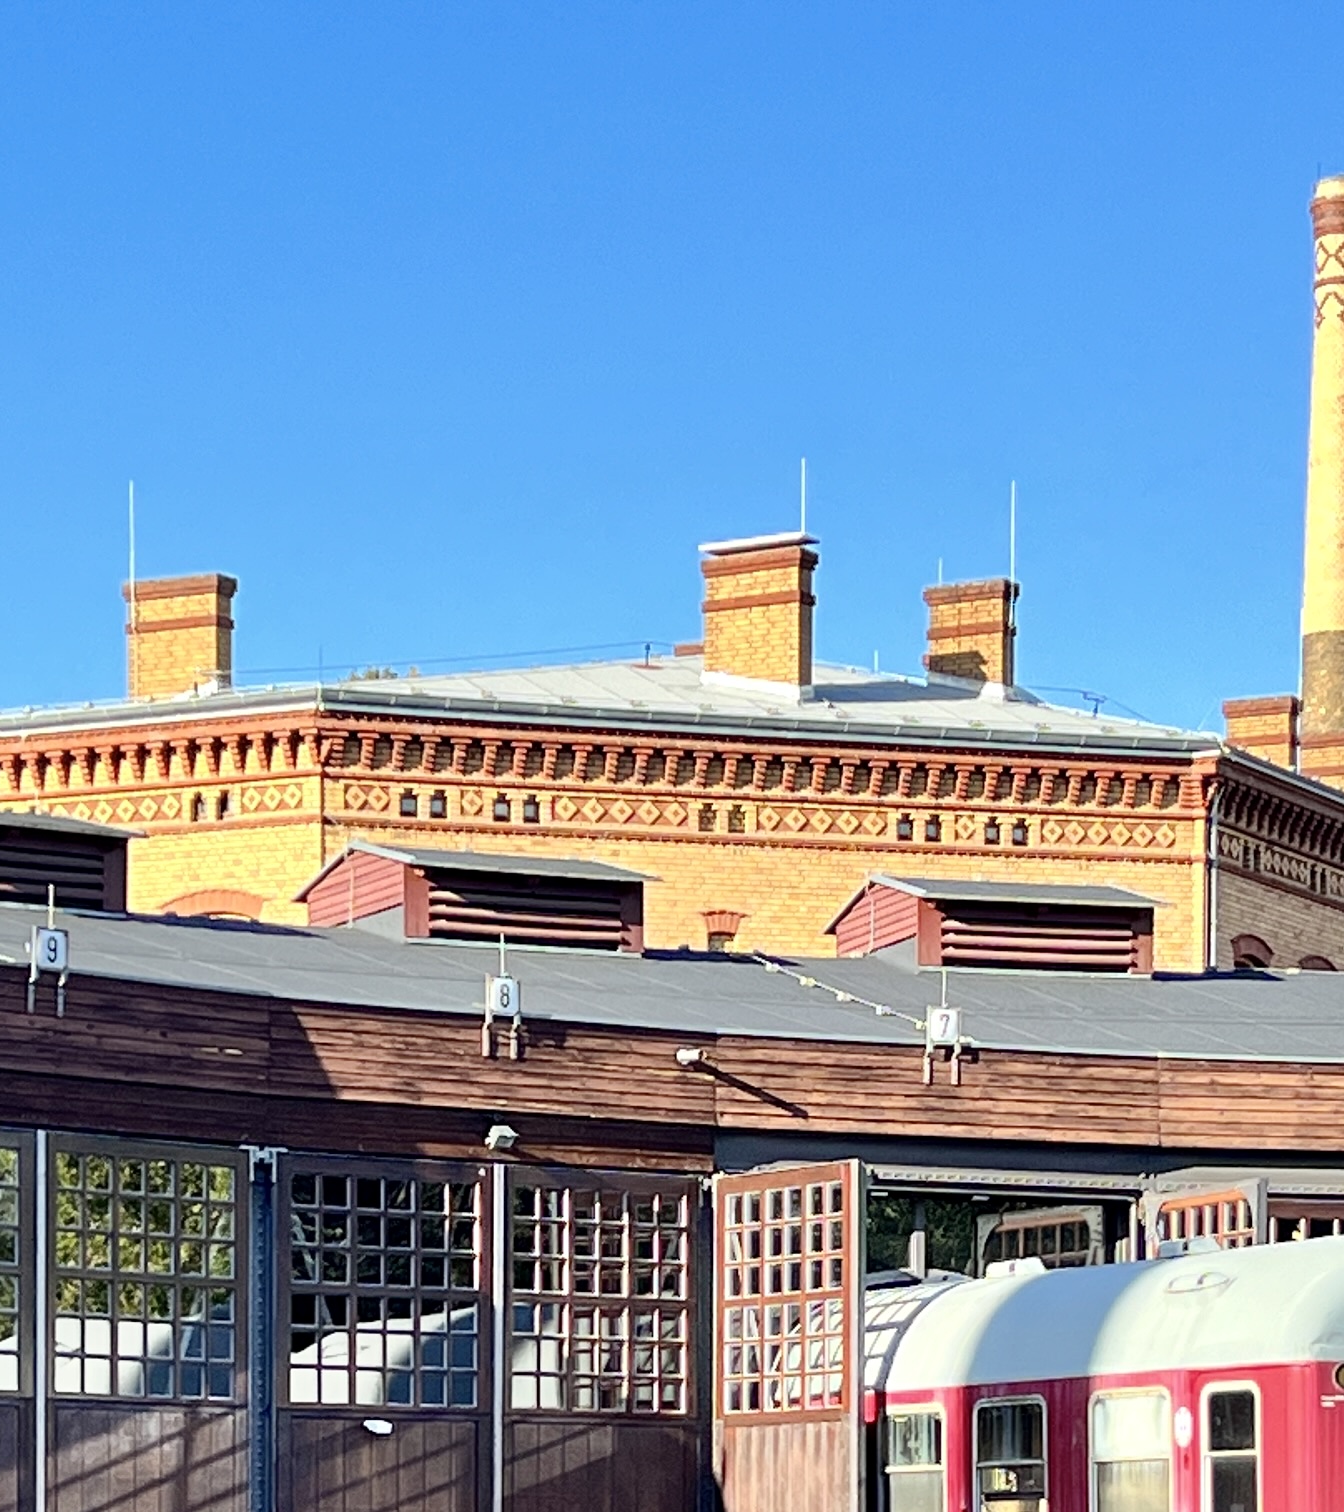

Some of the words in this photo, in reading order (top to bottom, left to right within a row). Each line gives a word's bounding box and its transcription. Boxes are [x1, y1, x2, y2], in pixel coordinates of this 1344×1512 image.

[47, 936, 58, 963] 9
[499, 984, 510, 1008] 8
[940, 1014, 950, 1038] 7
